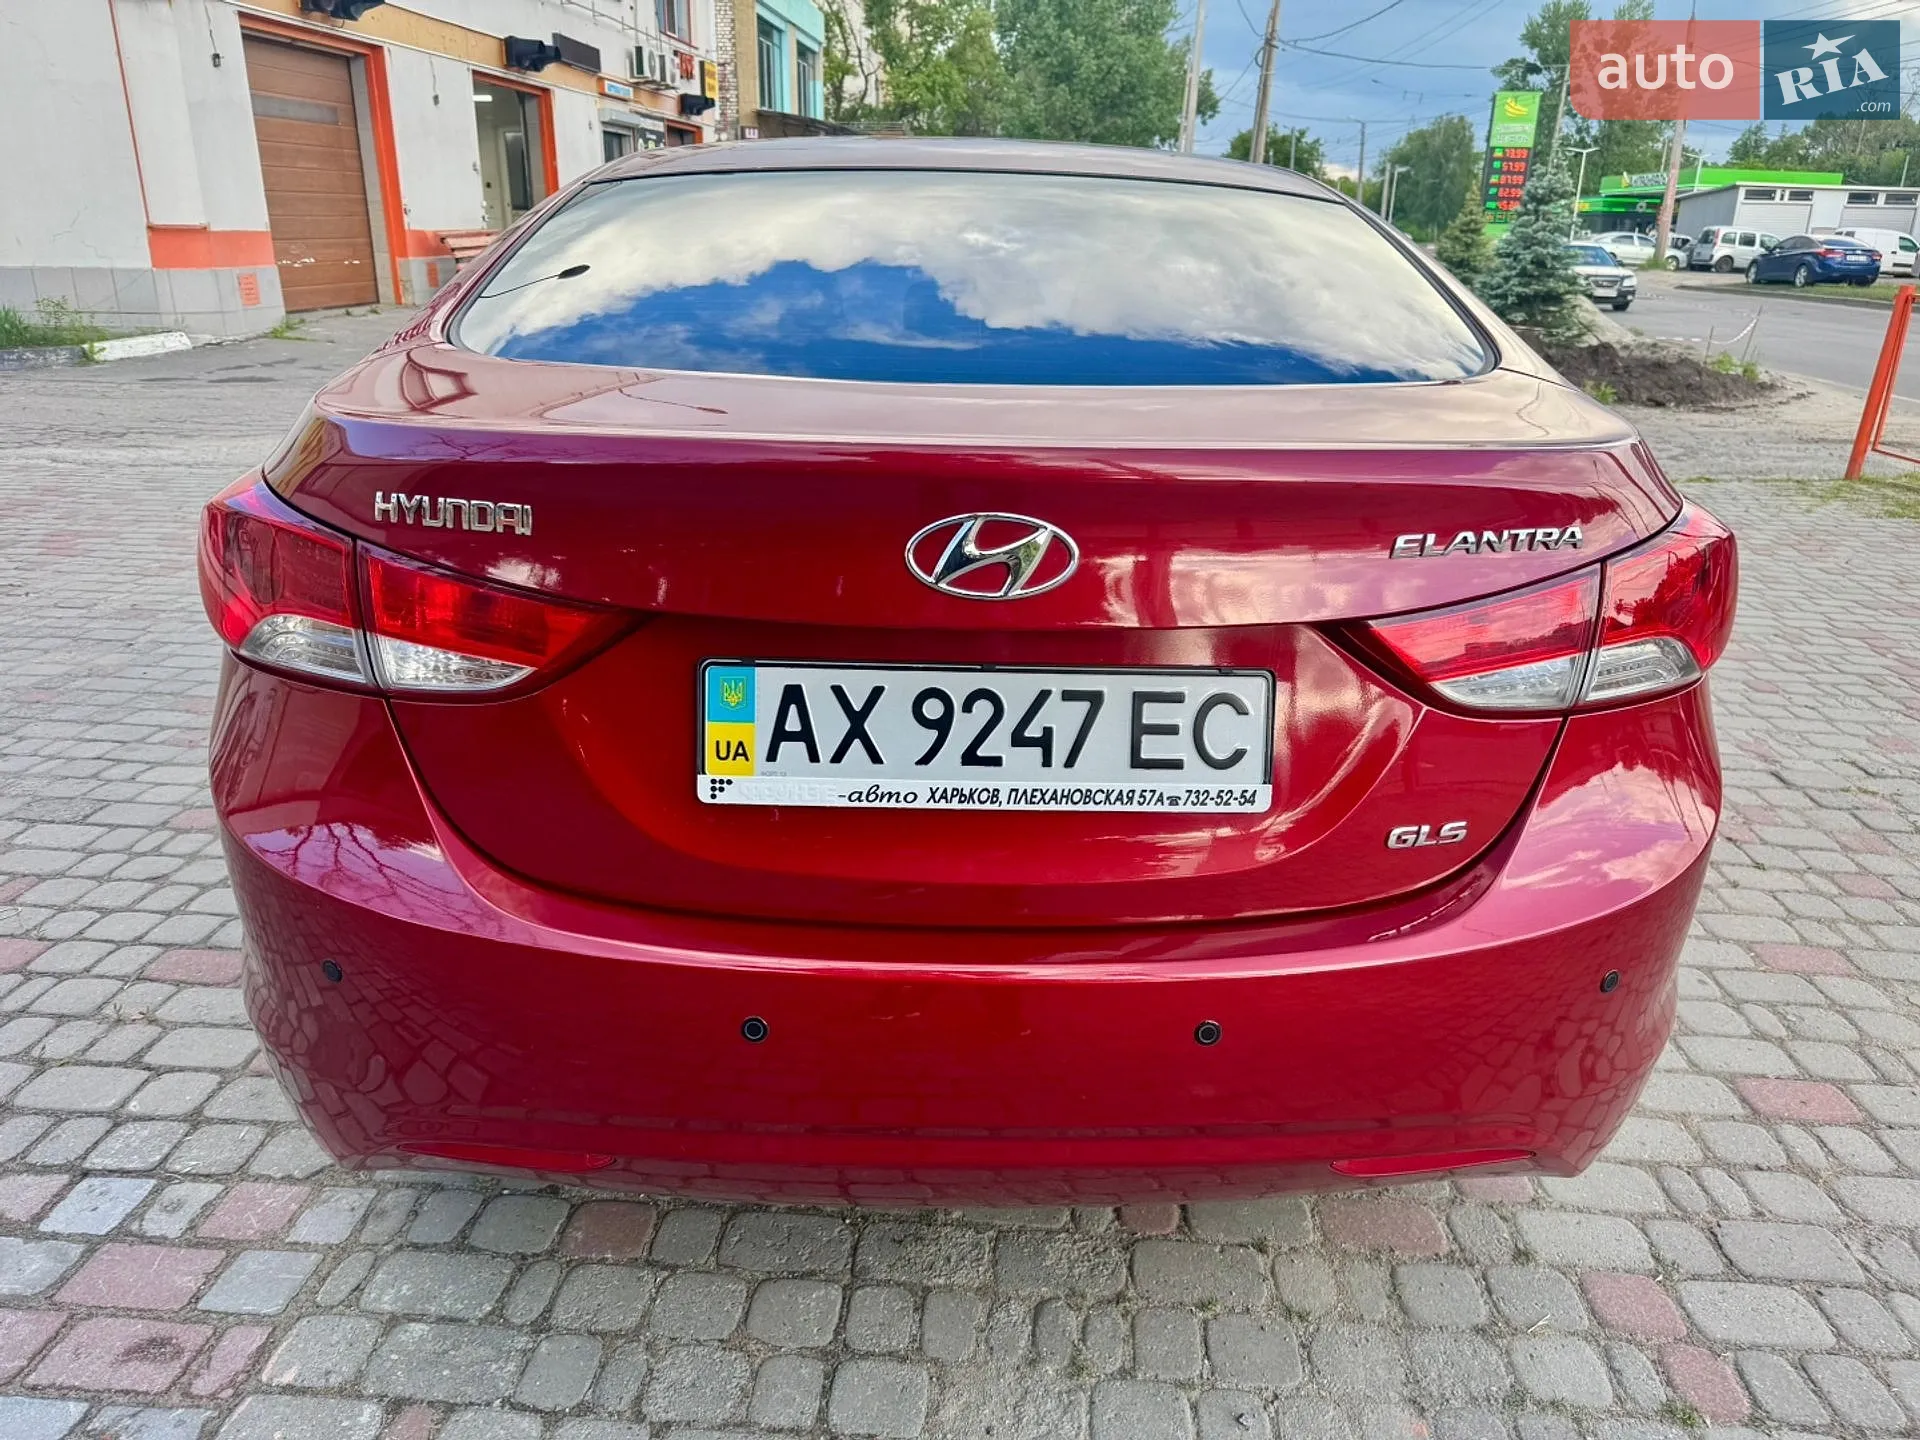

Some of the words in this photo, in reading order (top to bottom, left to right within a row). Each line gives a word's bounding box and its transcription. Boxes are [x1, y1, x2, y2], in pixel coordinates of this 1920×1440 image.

[374, 491, 533, 537] HYUNDAI
[1389, 526, 1584, 560] ELANTRA
[766, 684, 886, 765] AX
[911, 686, 1104, 769] 9247
[1130, 691, 1249, 771] EC
[715, 740, 750, 761] UA
[927, 787, 1002, 808] ХАРЬКОВ,
[1006, 788, 1136, 806] ПЛЕХАНОВСКАЯ
[1182, 789, 1257, 807] 732-52-54
[1386, 820, 1468, 850] GLS
